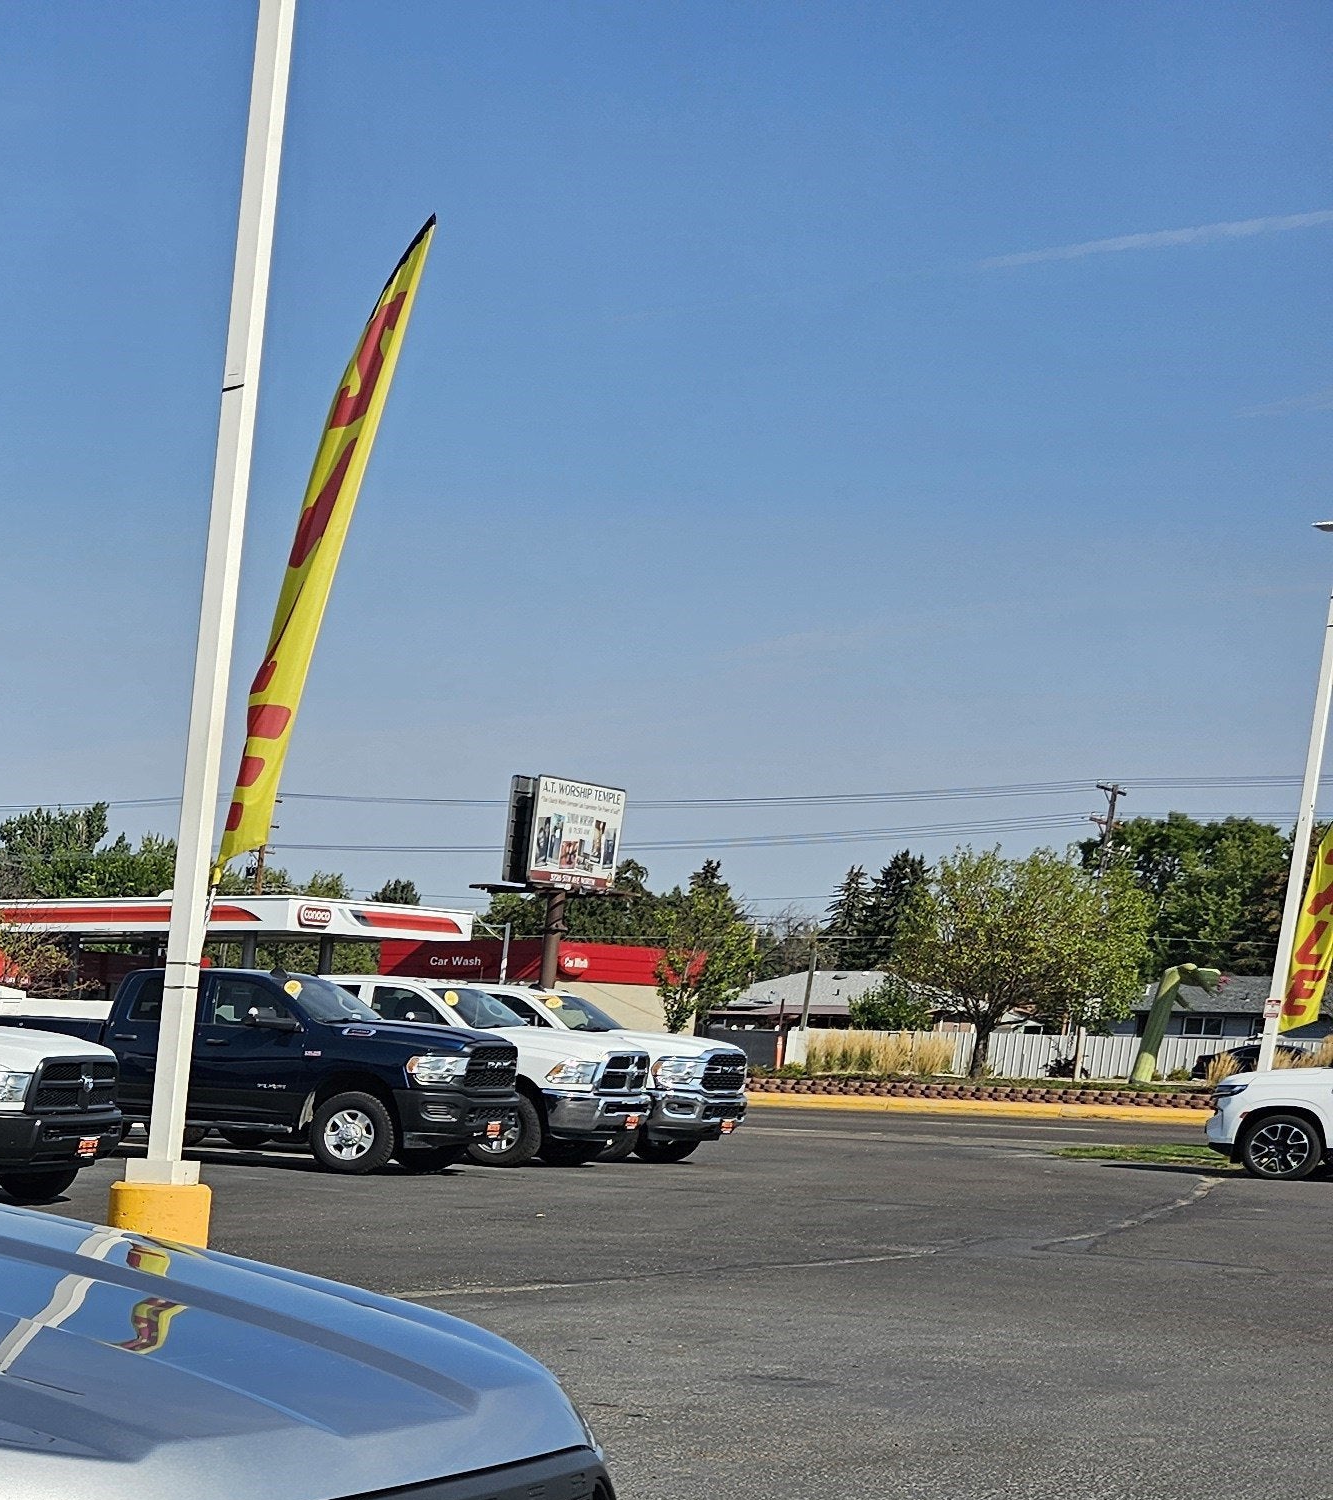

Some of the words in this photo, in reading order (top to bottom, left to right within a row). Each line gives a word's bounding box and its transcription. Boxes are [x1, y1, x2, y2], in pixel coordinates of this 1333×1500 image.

[558, 783, 593, 800] WORSHIP
[594, 790, 621, 806] TEMPLE
[1282, 847, 1333, 1017] ALE
[429, 956, 449, 966] Car
[451, 955, 482, 967] Wash
